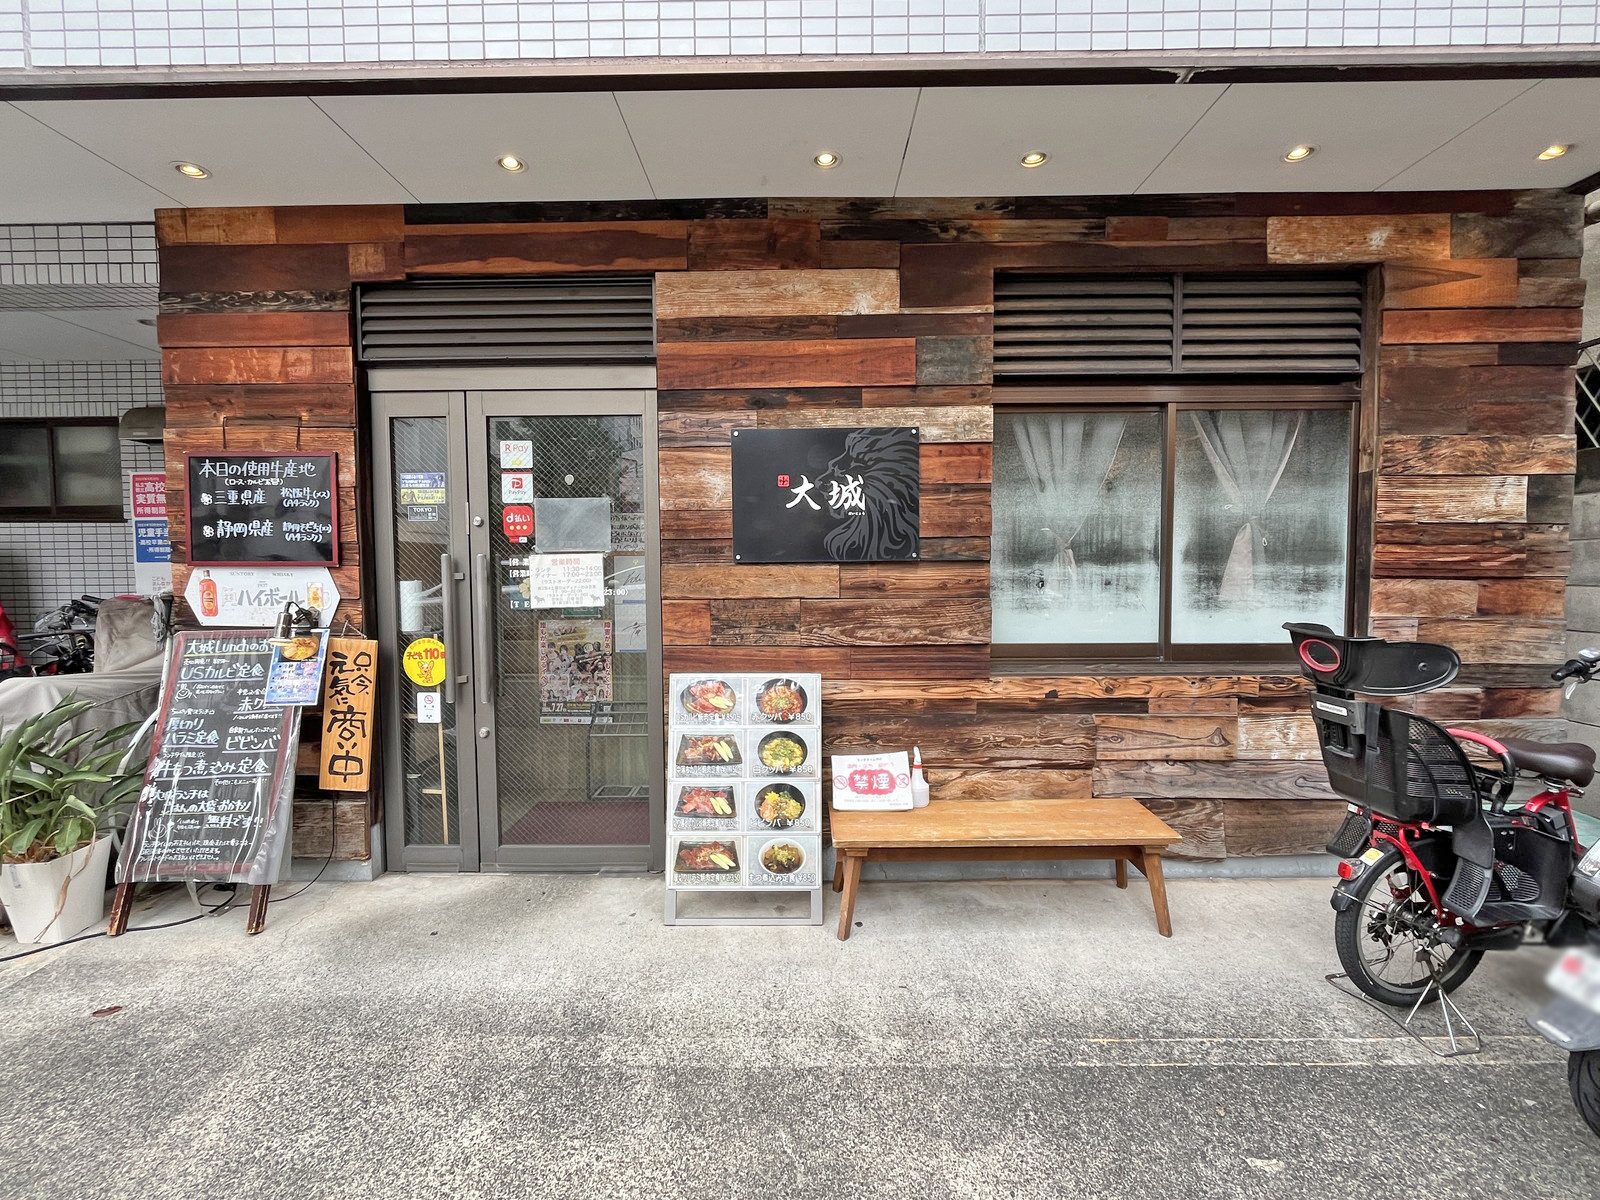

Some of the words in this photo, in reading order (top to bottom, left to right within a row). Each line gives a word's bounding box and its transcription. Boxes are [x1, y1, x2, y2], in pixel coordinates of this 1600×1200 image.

[512, 444, 529, 453] Pay
[199, 459, 317, 478] 本日の使用牛産地
[214, 488, 267, 506] 三重県産
[785, 474, 866, 511] 大城
[506, 512, 531, 523] d払い
[216, 519, 274, 539] 静岡県産
[237, 587, 306, 607] ハイボール
[181, 664, 264, 680] USカルビ定食
[166, 717, 204, 731] 厚切り
[787, 712, 812, 721] ¥850
[164, 730, 219, 745] ハラミ定食
[225, 734, 281, 750] ビビンバ
[789, 765, 813, 774] ¥850
[853, 773, 890, 790] 禁煙
[786, 818, 811, 827] ¥850
